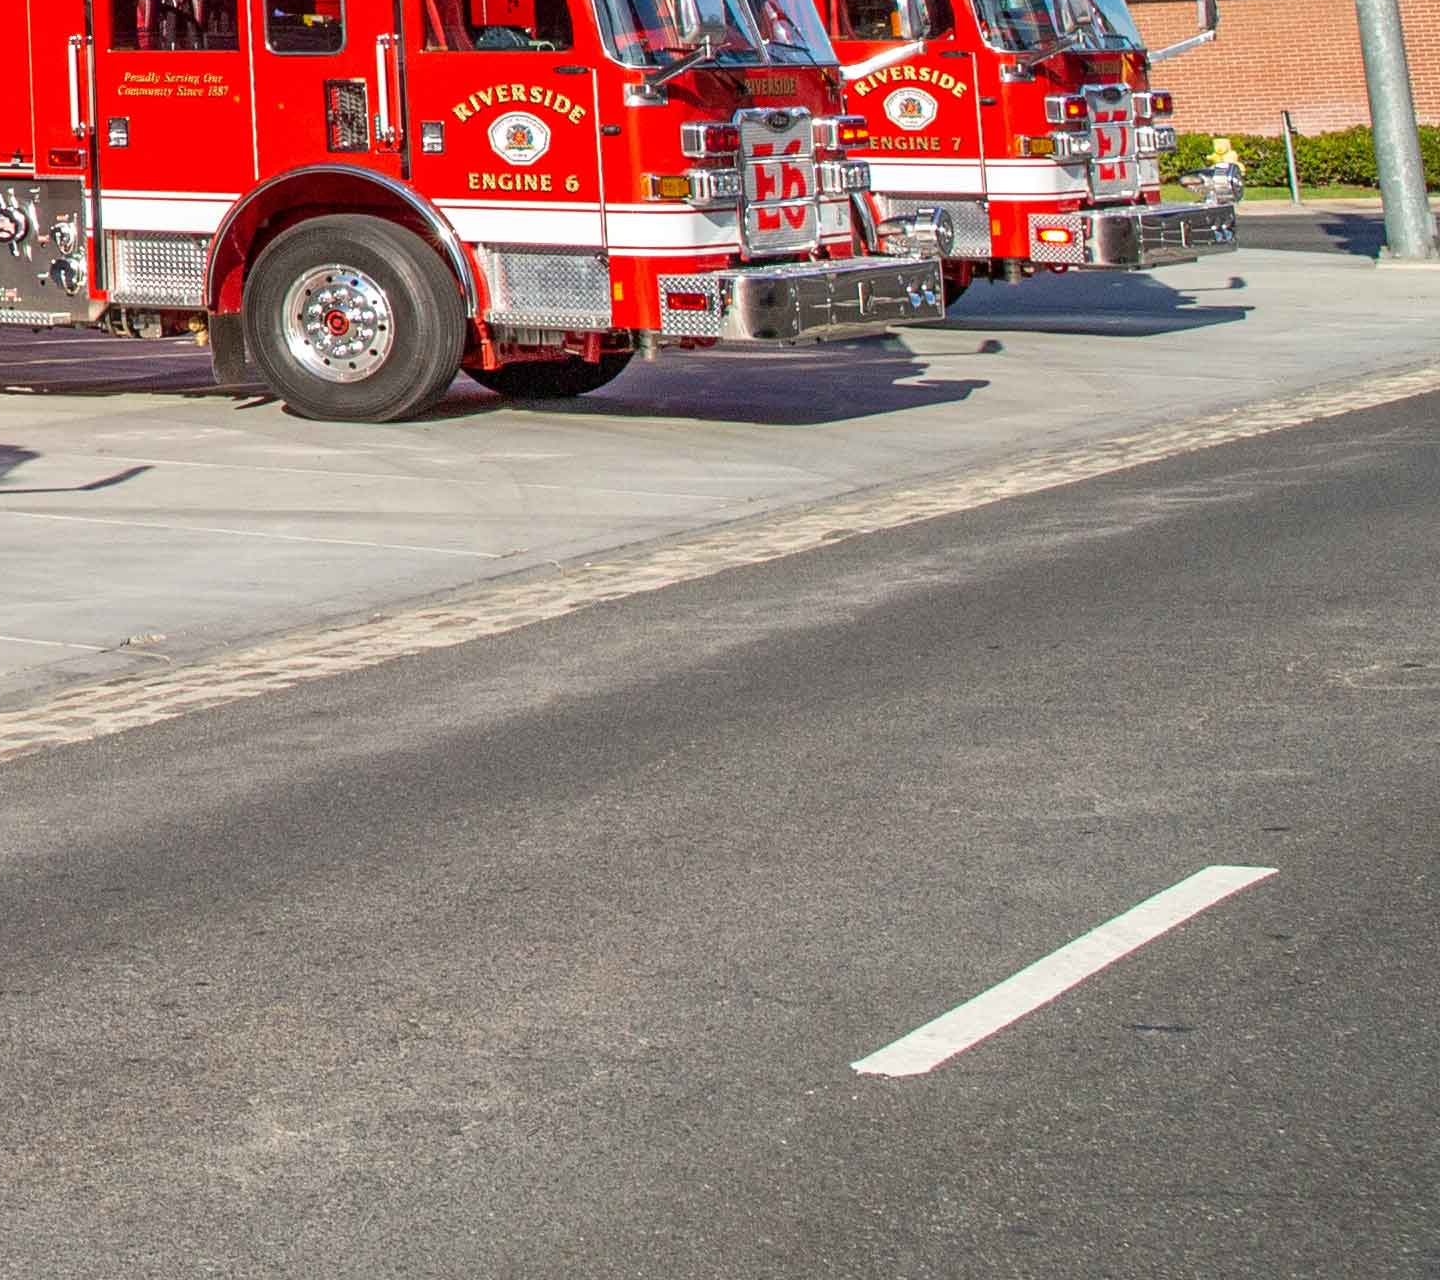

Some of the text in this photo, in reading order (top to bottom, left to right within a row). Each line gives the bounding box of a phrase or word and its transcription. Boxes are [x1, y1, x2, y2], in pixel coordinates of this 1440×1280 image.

[124, 71, 224, 86] Proudly Serving Our
[854, 65, 968, 98] RIVERSIDE
[117, 84, 174, 97] Community
[176, 86, 205, 97] Since
[452, 83, 587, 125] RIVERSIDE
[869, 136, 961, 152] ENGINE 7
[467, 172, 580, 192] ENGINE 6
[751, 139, 808, 232] E6
